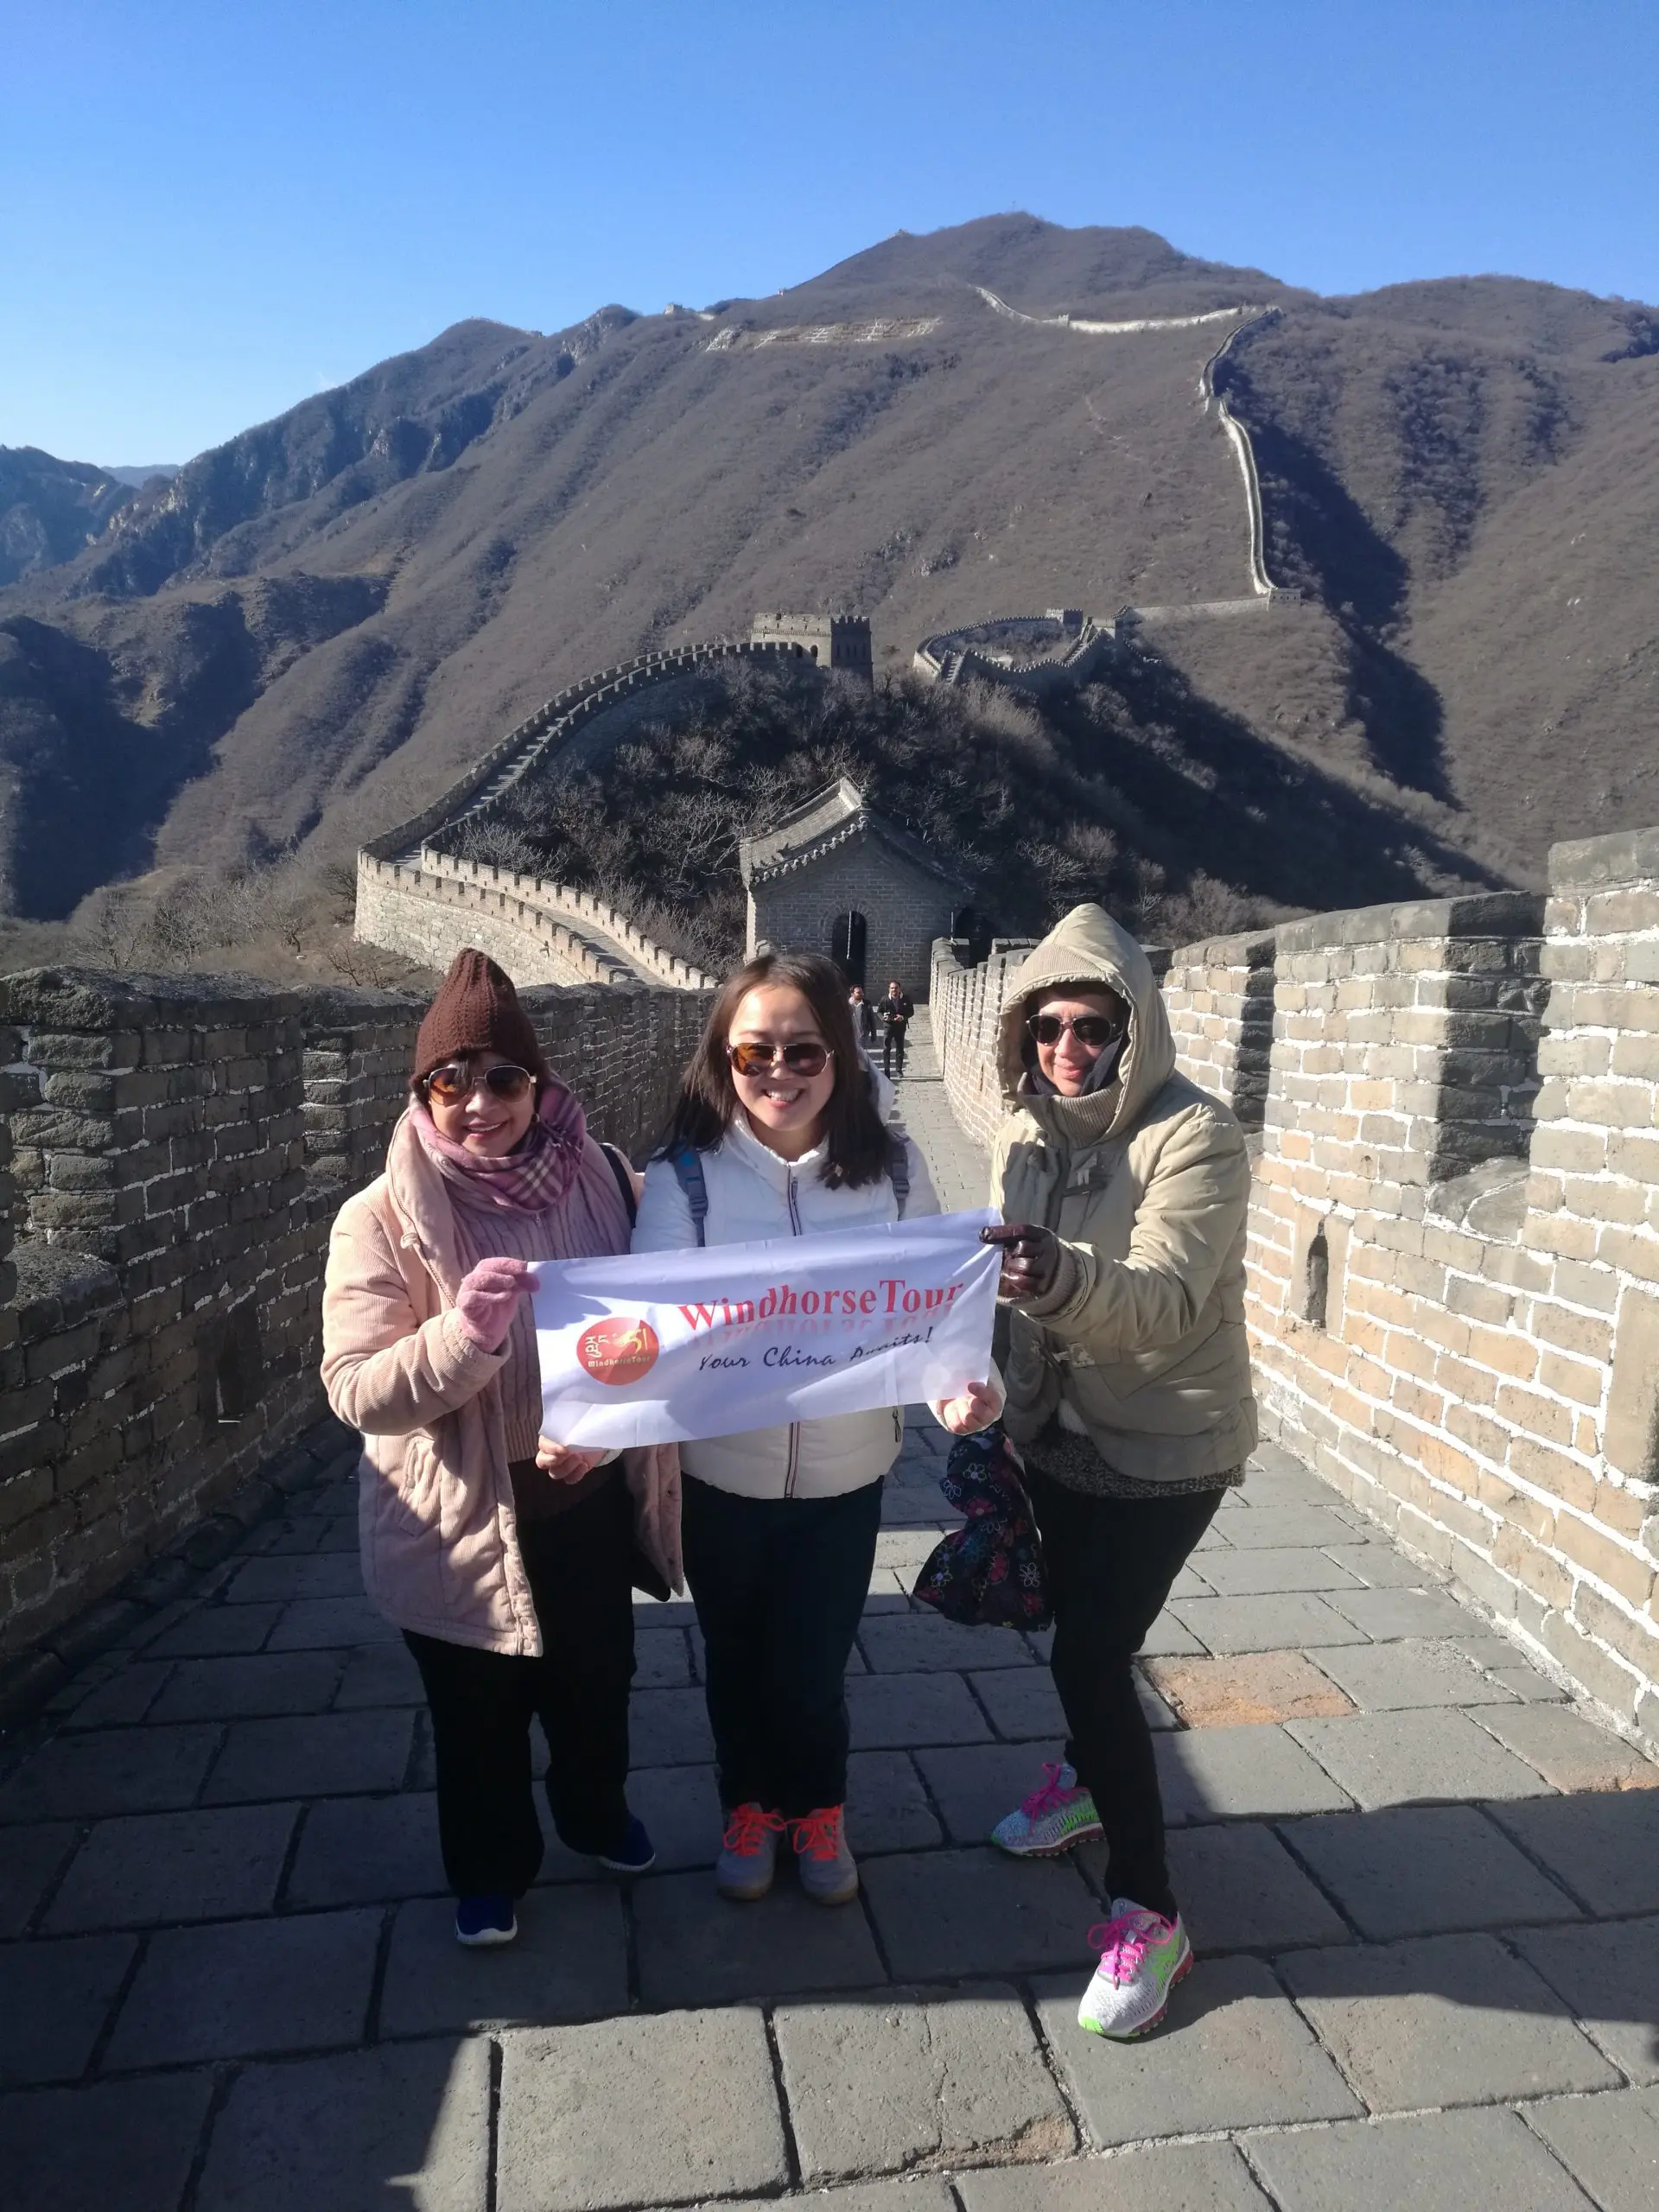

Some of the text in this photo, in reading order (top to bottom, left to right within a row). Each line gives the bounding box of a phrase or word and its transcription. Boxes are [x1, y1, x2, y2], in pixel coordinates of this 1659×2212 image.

[677, 1279, 964, 1332] WindhorseTour
[698, 1325, 934, 1371] Your China Aits!
